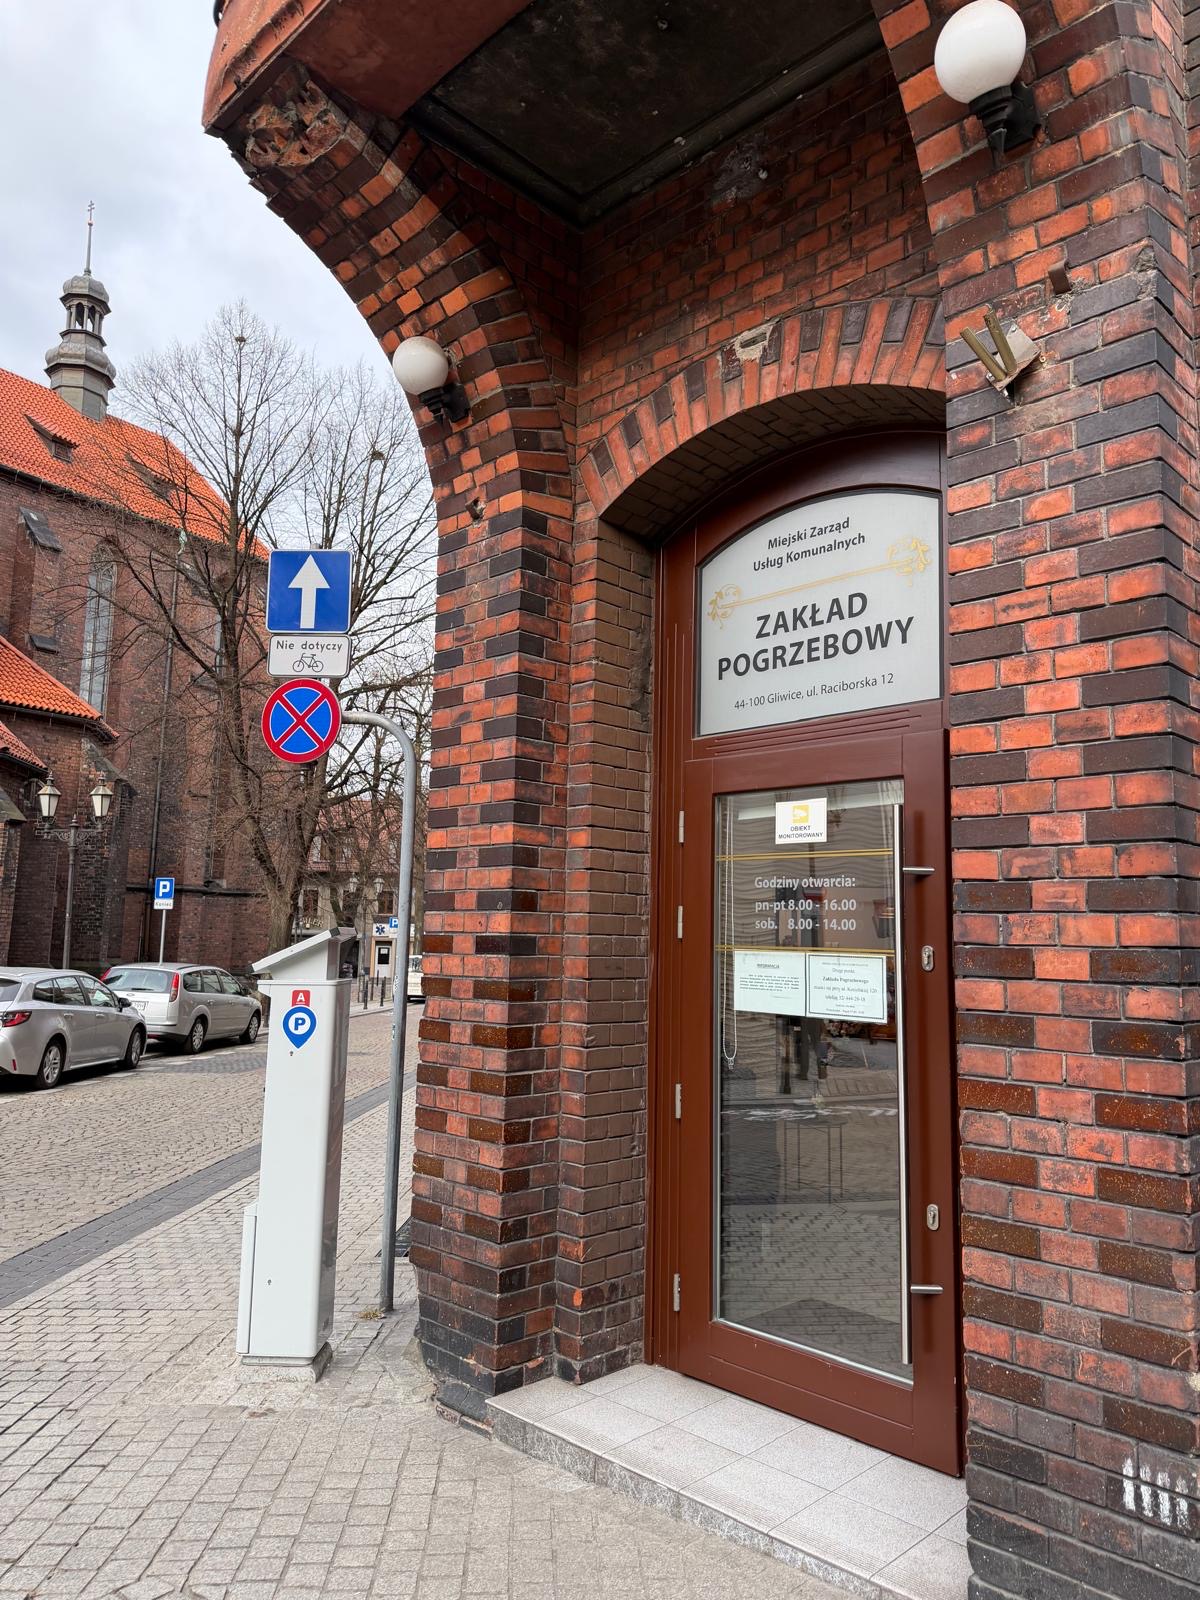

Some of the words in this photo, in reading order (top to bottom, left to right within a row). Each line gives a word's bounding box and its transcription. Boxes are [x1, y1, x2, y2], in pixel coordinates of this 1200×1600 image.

[767, 528, 807, 550] Miejski
[809, 517, 850, 539] Zarząd
[753, 552, 783, 571] Usług
[786, 532, 866, 564] Komunalnych
[755, 592, 868, 639] ZAKŁAD
[276, 640, 295, 650] Nie
[301, 640, 343, 654] dotyczy
[718, 616, 915, 681] POGRZEBOWY
[734, 695, 766, 710] 44-100
[767, 687, 804, 704] Gliwice,
[806, 684, 818, 698] ul.
[820, 676, 877, 695] Raciborska
[881, 673, 894, 685] 12
[158, 880, 171, 897] P
[754, 876, 799, 890] Godziny
[801, 874, 856, 887] otwarcia:
[755, 901, 786, 913] pn-pt
[788, 899, 812, 911] 8.00
[823, 898, 857, 911] 16.00
[754, 917, 778, 930] sob.
[788, 919, 812, 930] 8.00
[823, 918, 857, 931] 14.00
[296, 992, 306, 1002] A
[293, 1017, 306, 1031] P
